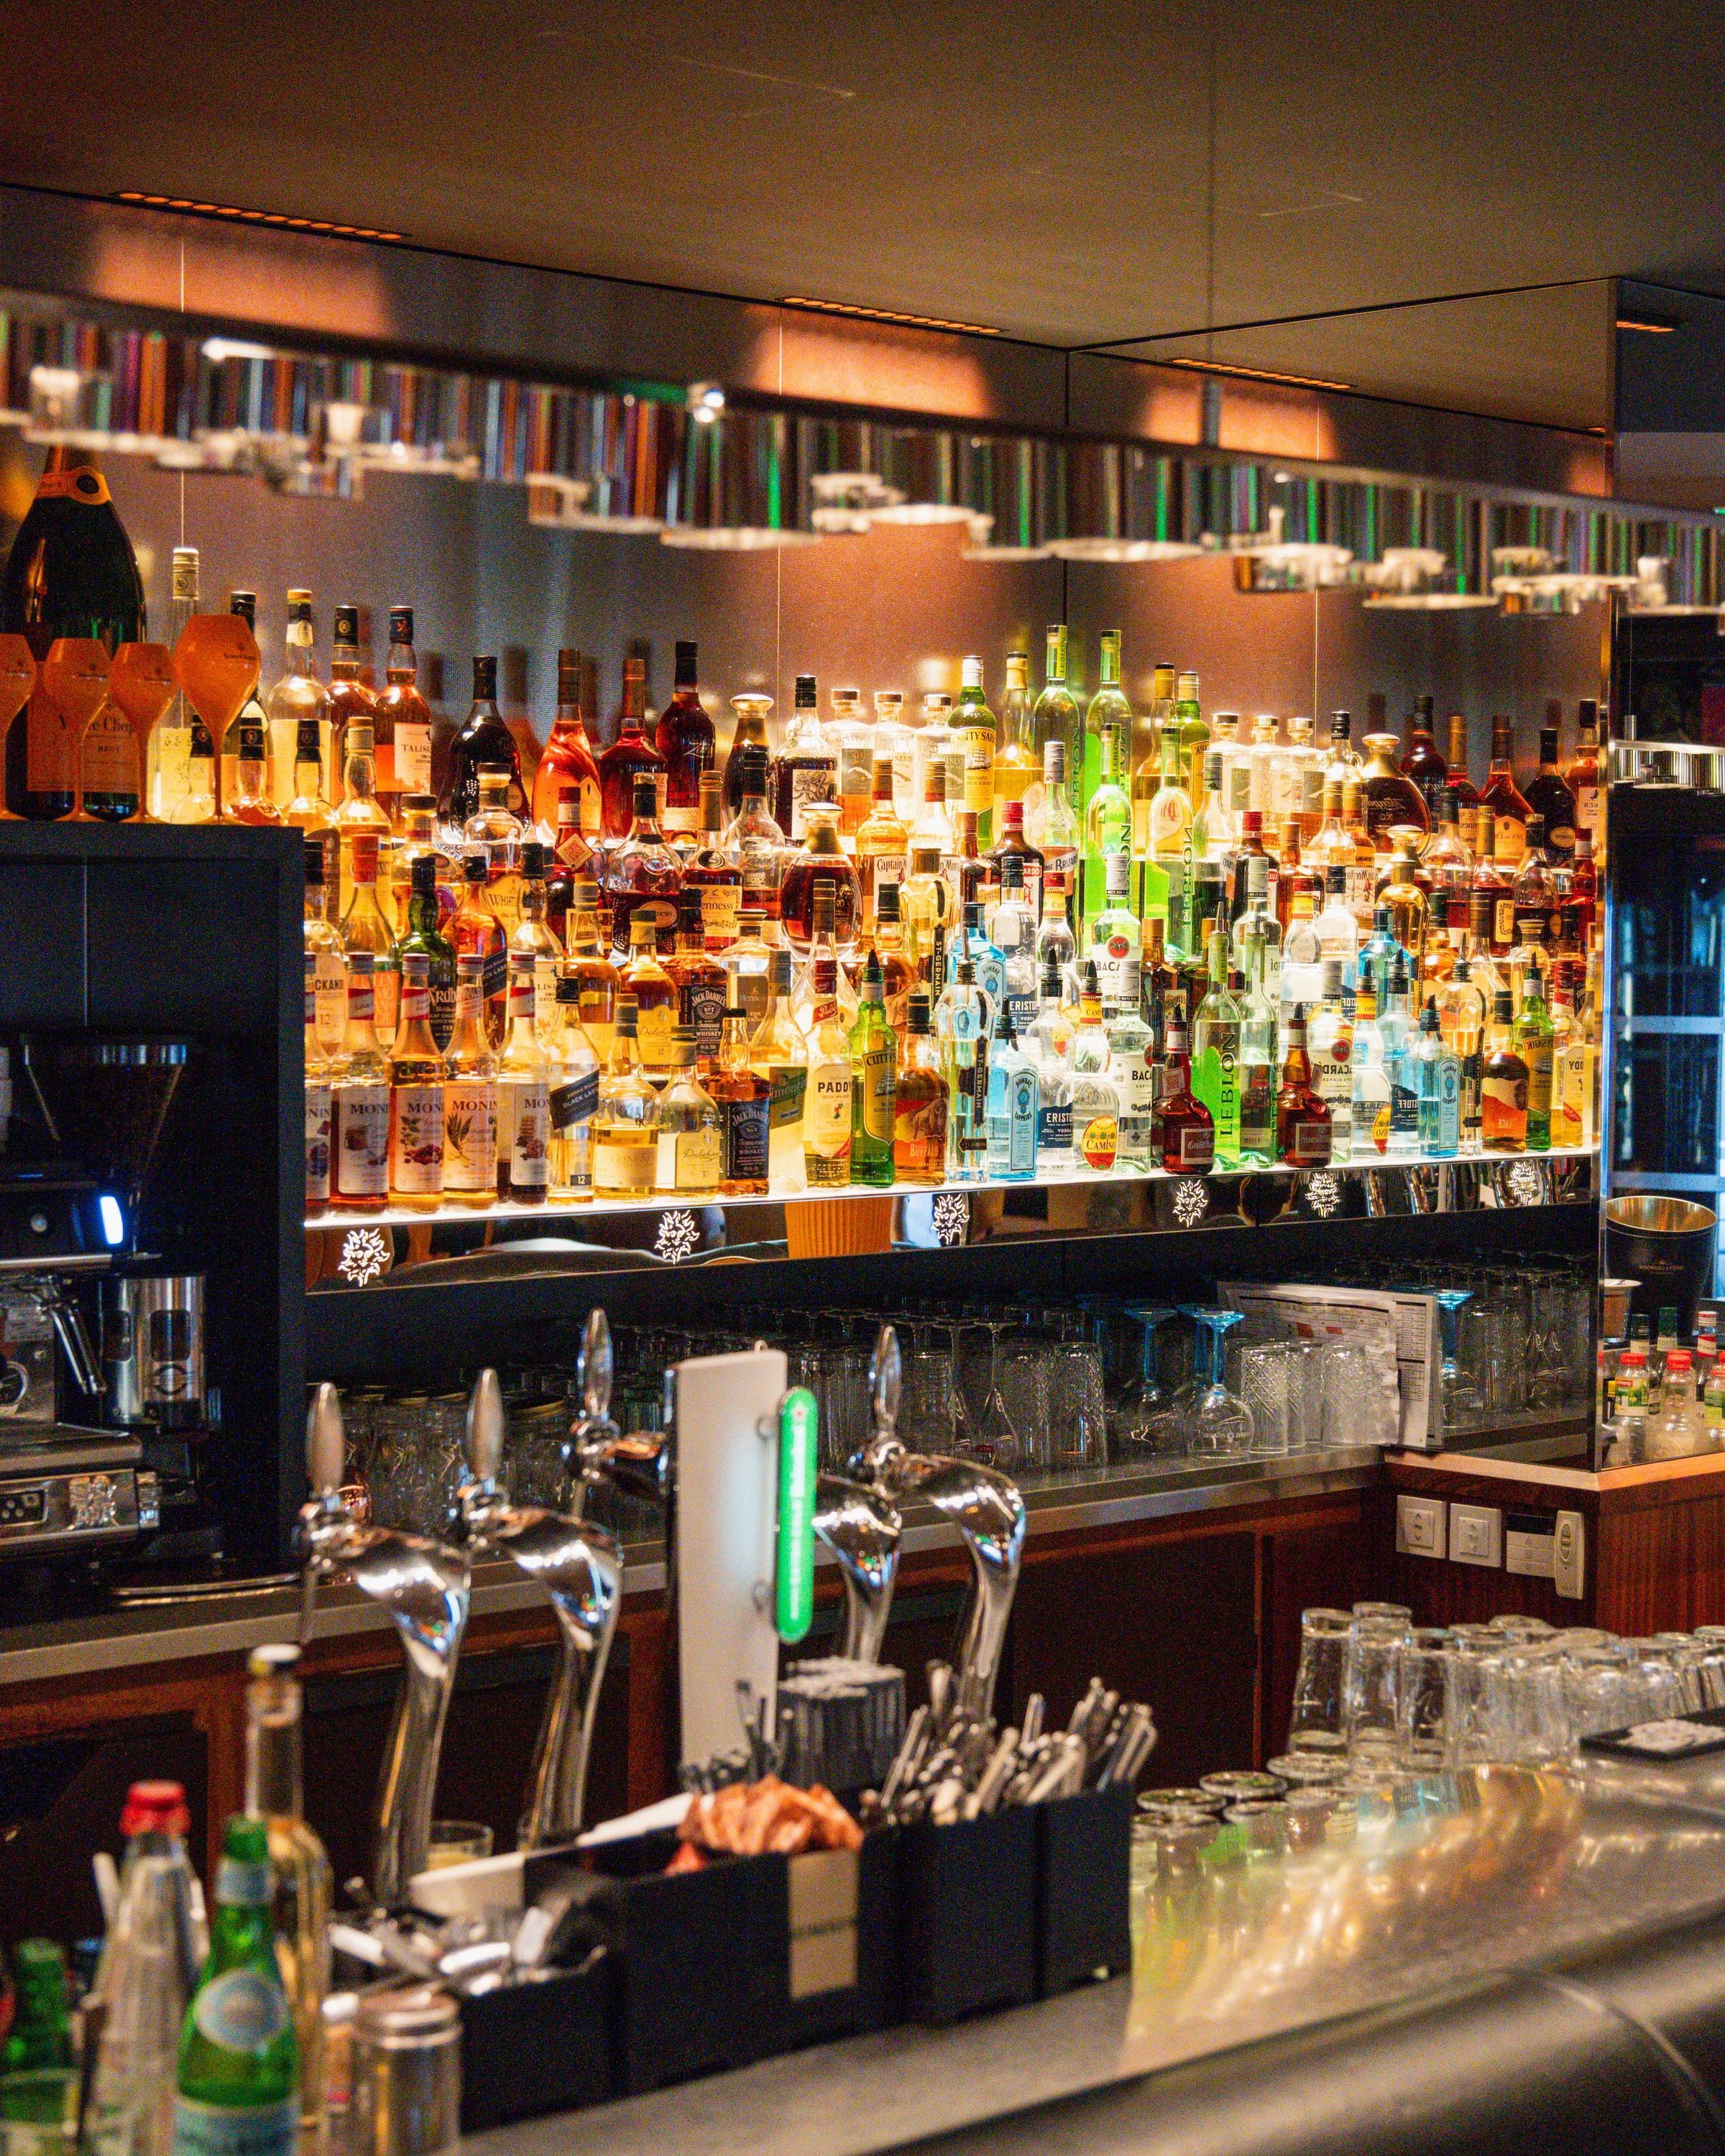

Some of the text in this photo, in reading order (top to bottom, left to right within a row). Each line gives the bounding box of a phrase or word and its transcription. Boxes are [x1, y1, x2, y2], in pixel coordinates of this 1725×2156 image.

[934, 941, 943, 996] ST-GERMAIN
[983, 965, 1000, 975] BOMBAY
[691, 992, 706, 1007] JACK
[320, 1014, 331, 1025] 12
[976, 1053, 985, 1108] ST-GERMAIN
[1015, 1077, 1033, 1088] BOMBAY
[1219, 1031, 1236, 1136] LEBLON
[1013, 1113, 1033, 1122] SAPPHIRE
[909, 1143, 939, 1157] BUFFALO
[1086, 1139, 1116, 1151] CAMINO
[577, 1175, 586, 1185] 12
